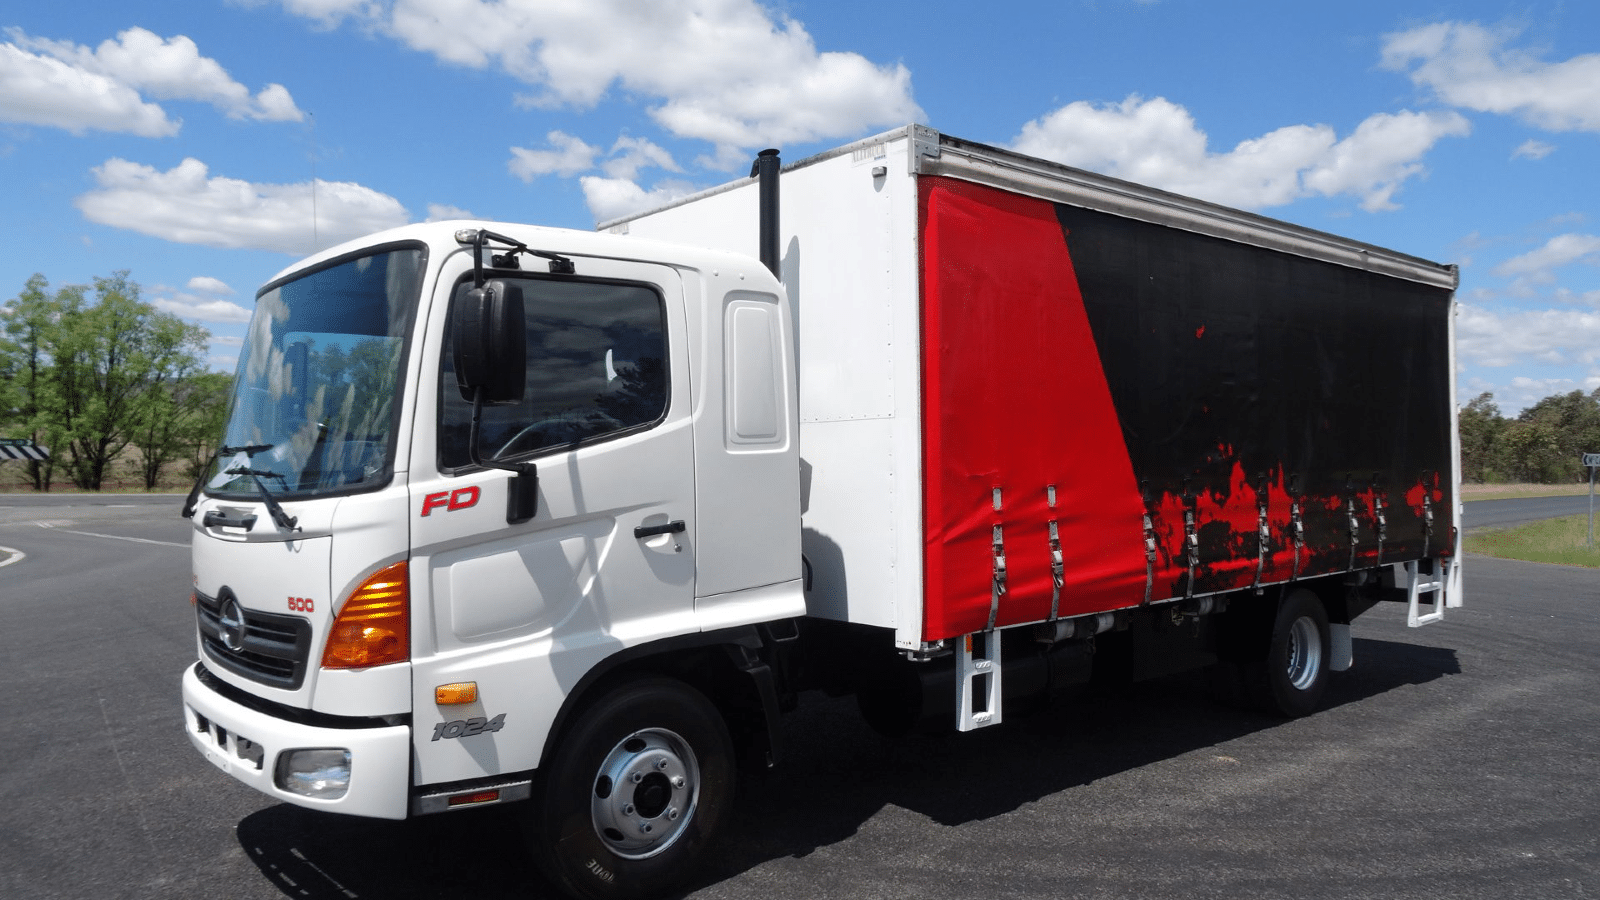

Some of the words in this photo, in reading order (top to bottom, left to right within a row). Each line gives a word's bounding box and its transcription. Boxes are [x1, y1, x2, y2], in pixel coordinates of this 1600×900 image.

[420, 485, 480, 517] FD
[287, 597, 314, 612] 500
[431, 713, 507, 741] 1024
